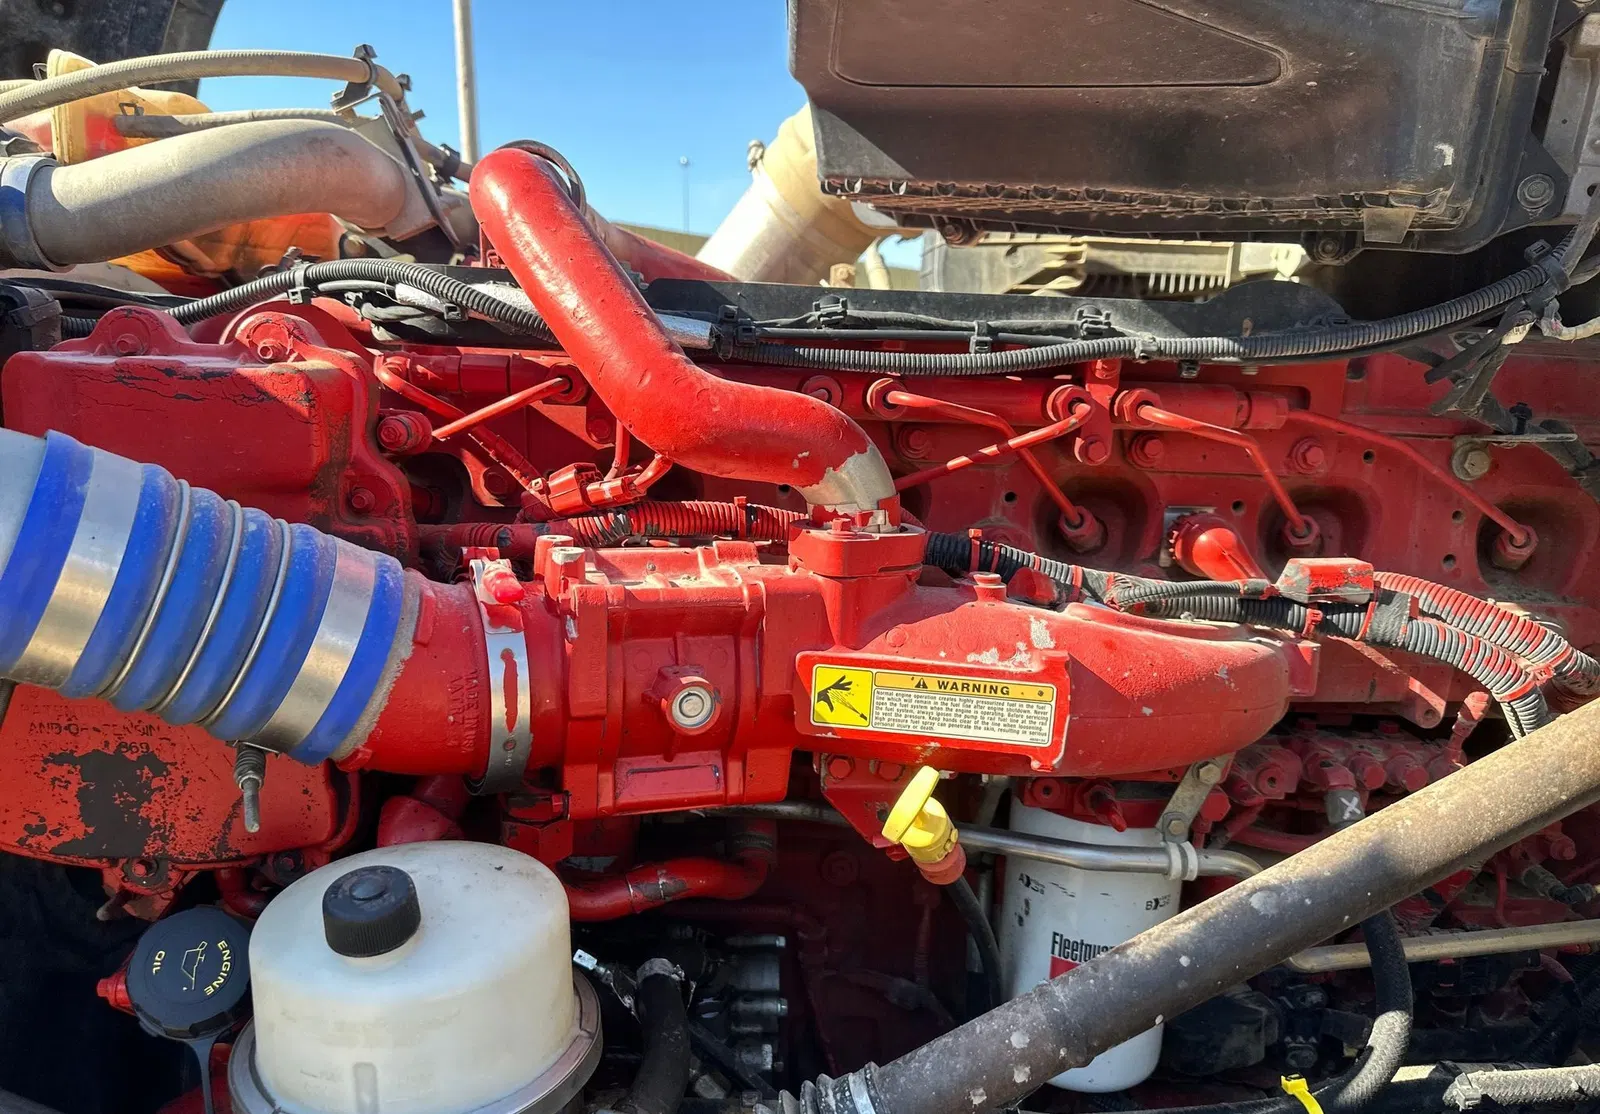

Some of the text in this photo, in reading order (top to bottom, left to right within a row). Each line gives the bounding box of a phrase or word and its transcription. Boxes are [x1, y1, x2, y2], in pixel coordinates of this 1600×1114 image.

[937, 680, 1010, 696] WARNING
[975, 699, 1005, 707] pressurized
[997, 727, 1020, 735] resulting
[152, 950, 166, 976] OIL
[204, 940, 231, 995] ENGINE
